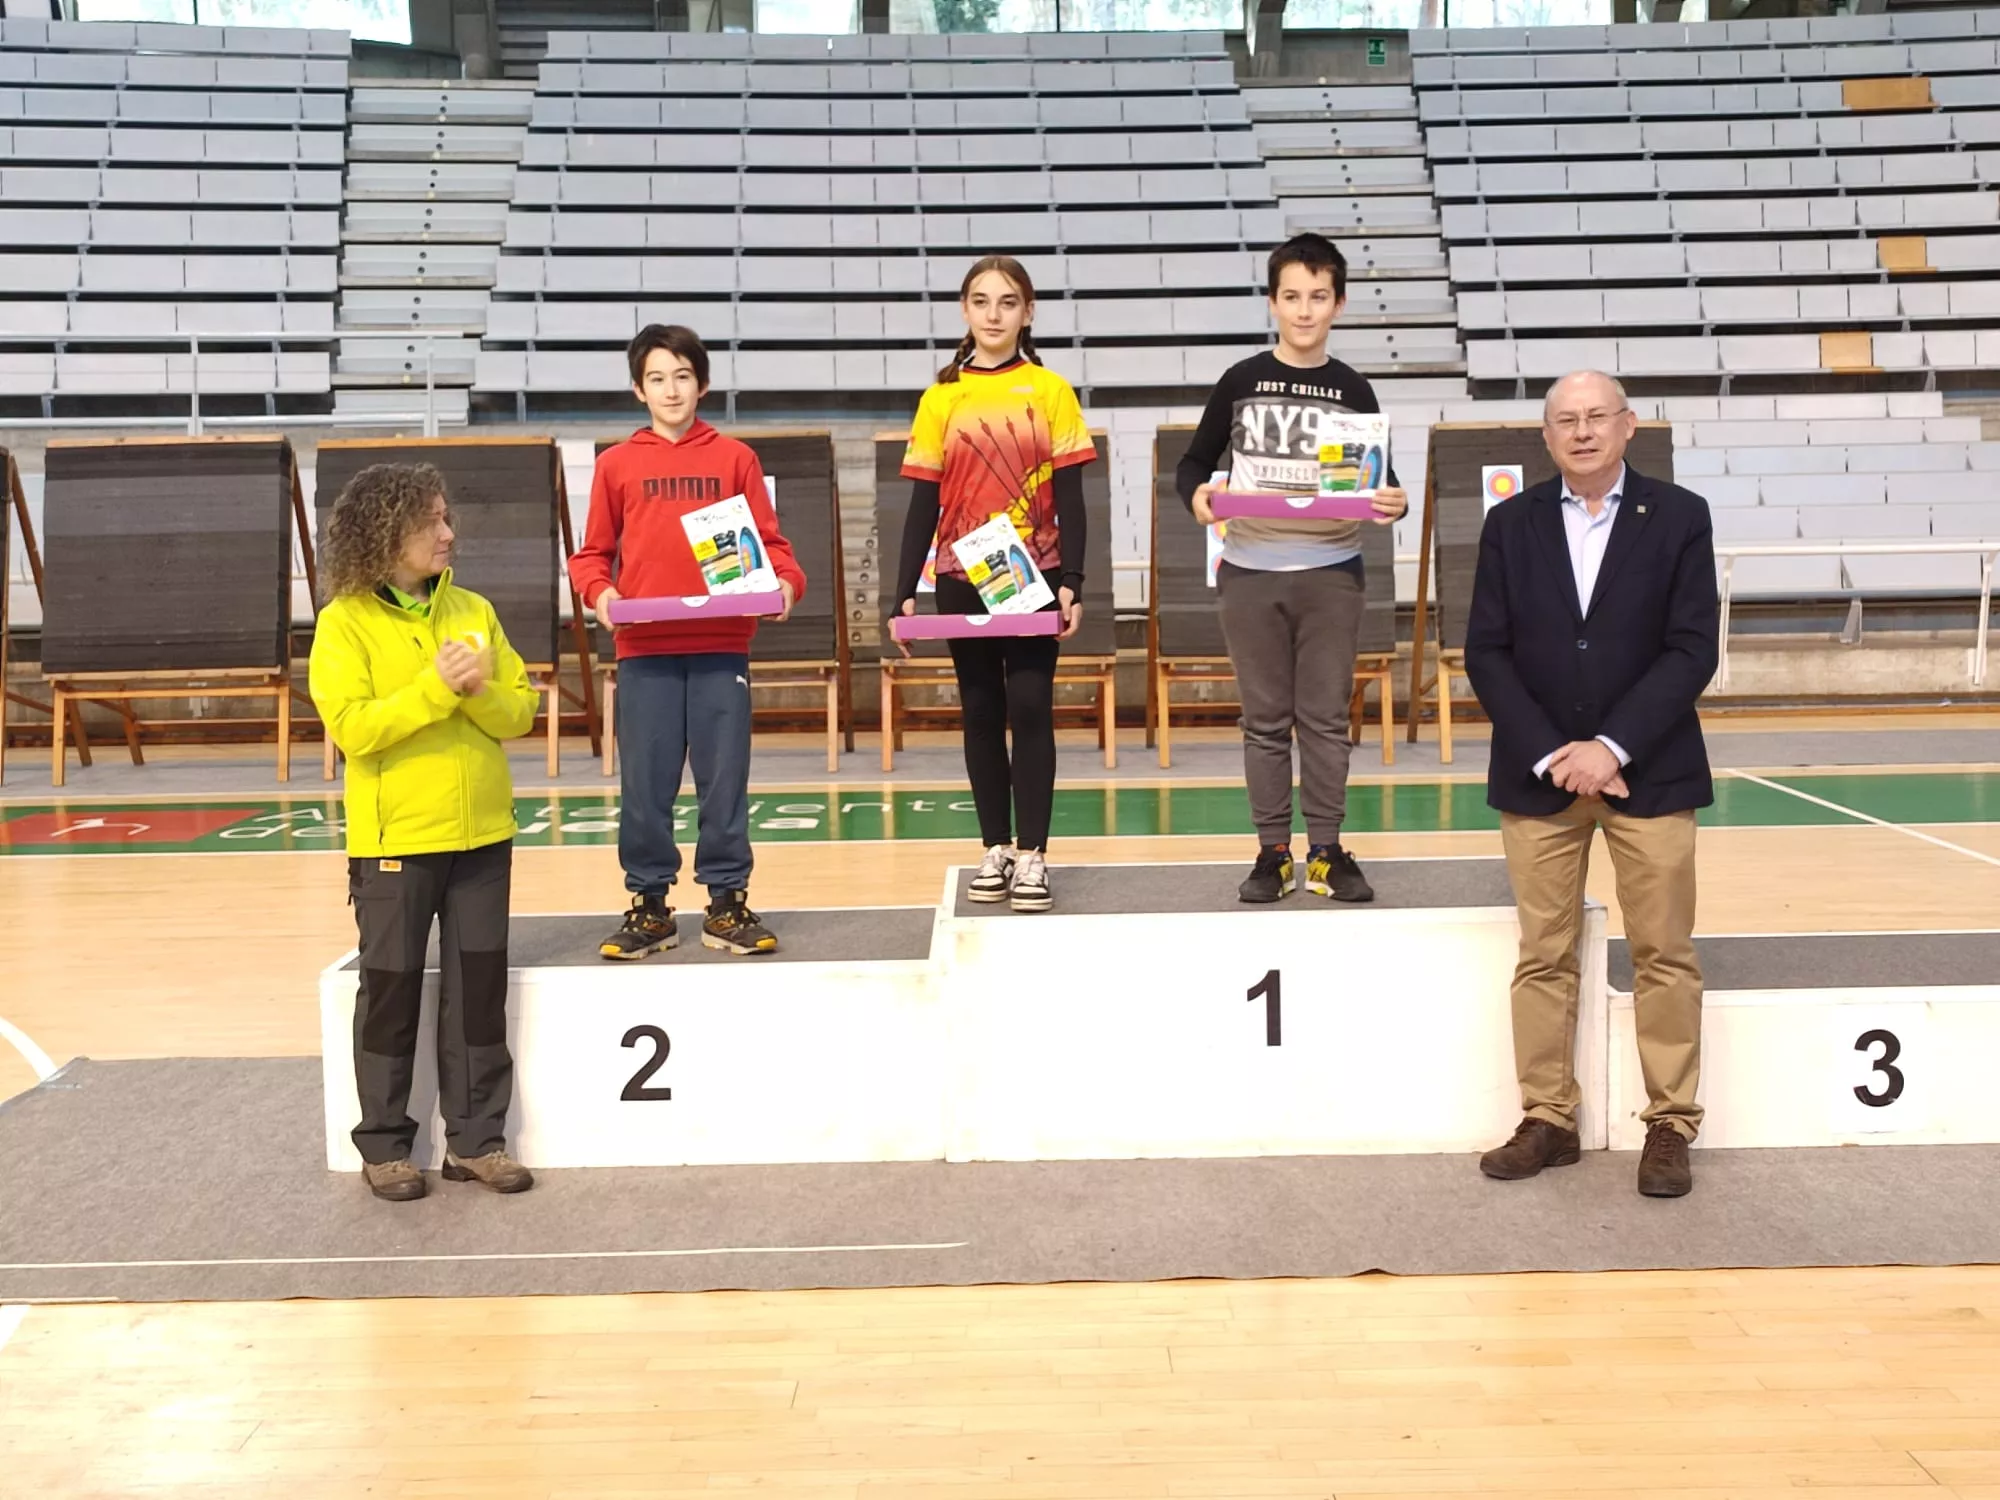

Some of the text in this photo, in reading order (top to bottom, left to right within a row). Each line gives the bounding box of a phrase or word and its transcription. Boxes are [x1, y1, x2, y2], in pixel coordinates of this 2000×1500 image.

[1255, 381, 1342, 400] JUST CHILLAX
[642, 476, 722, 502] PUMA
[1246, 968, 1281, 1046] 1
[620, 1024, 671, 1101] 2
[1853, 1029, 1904, 1107] 3
